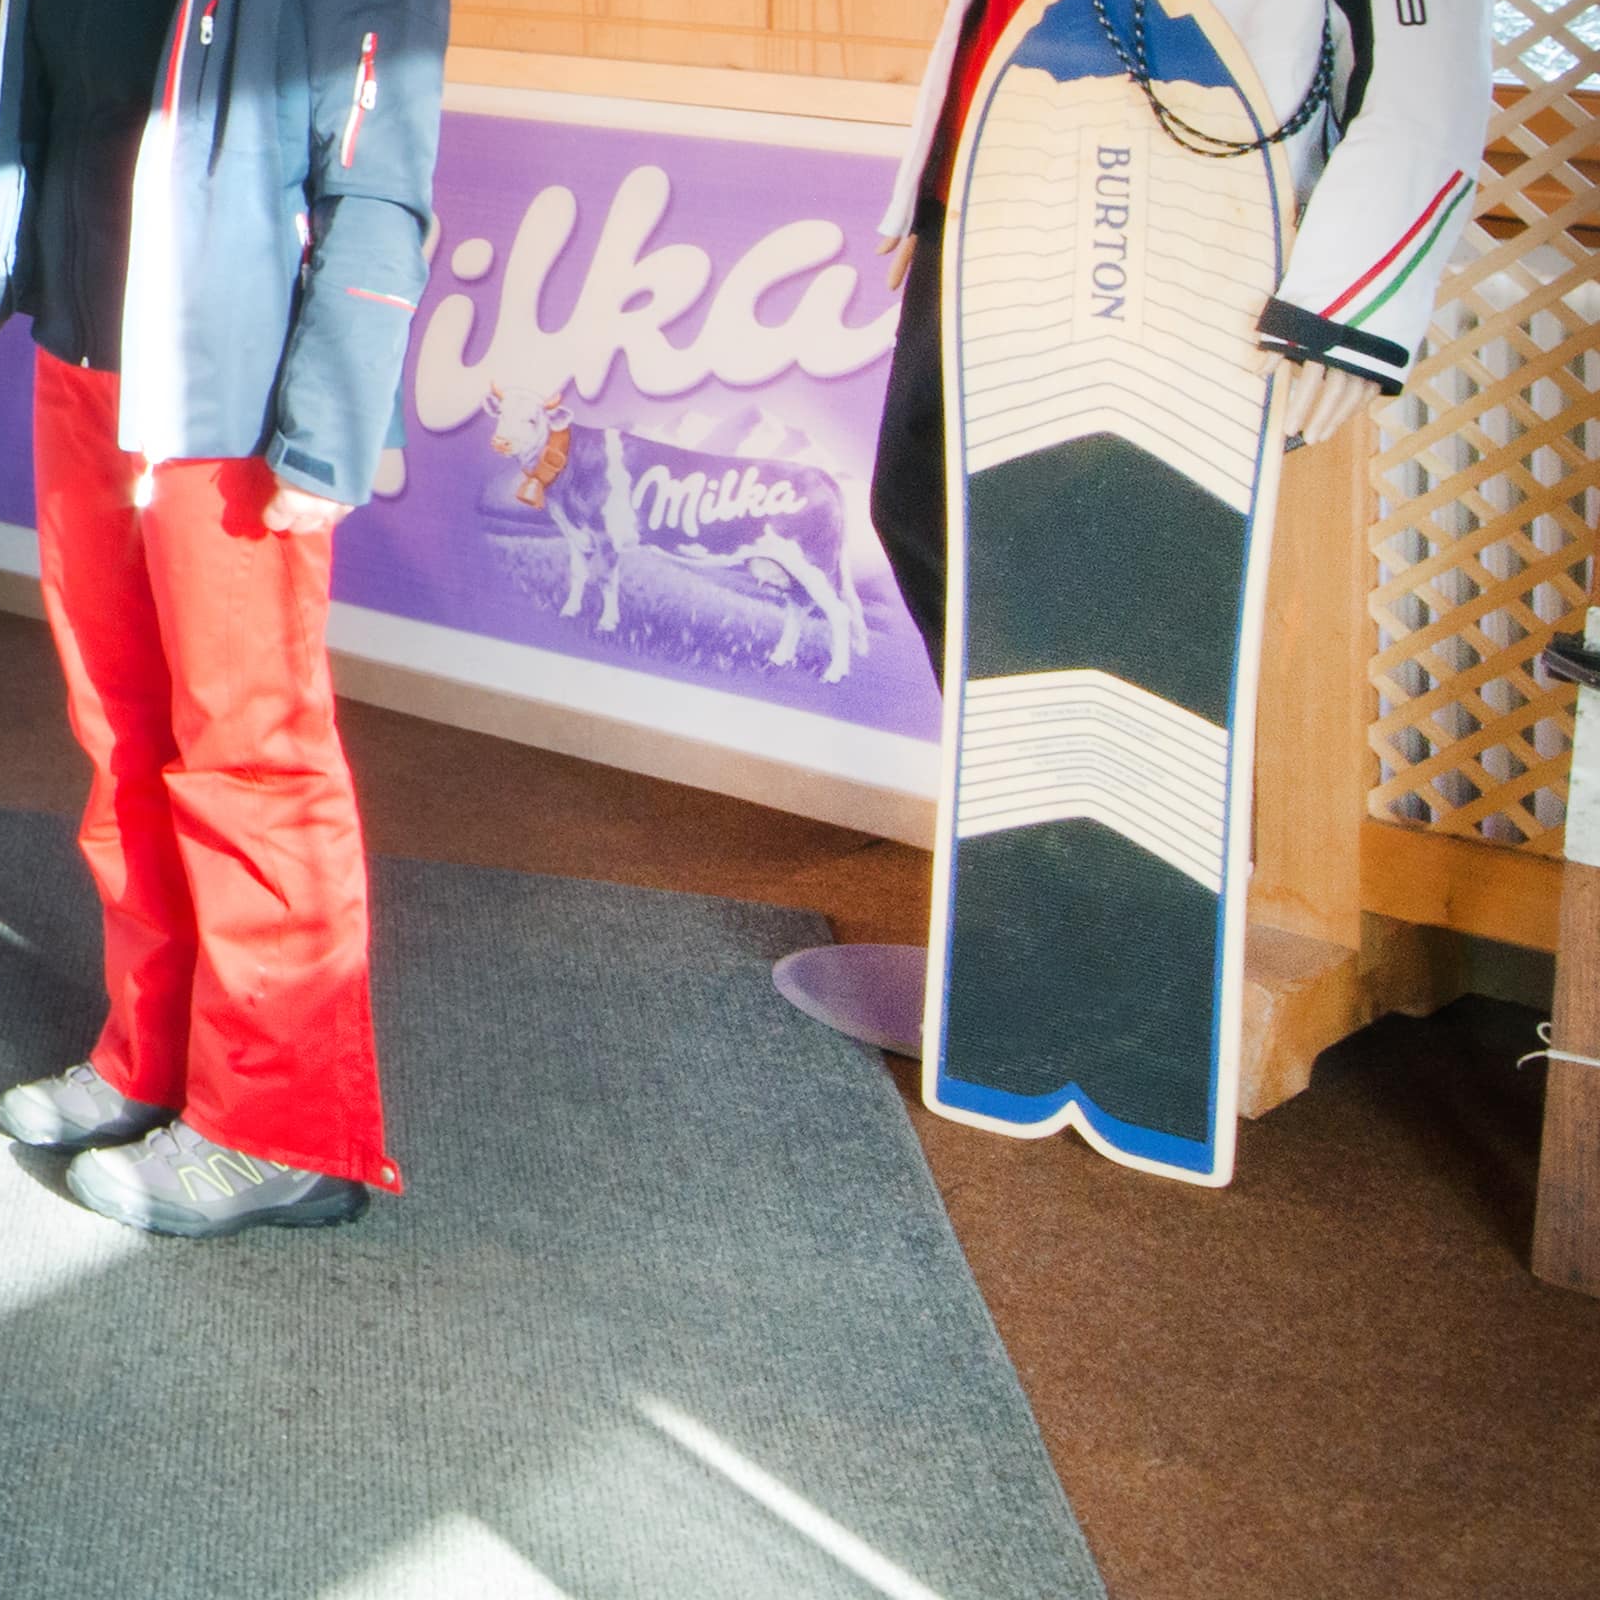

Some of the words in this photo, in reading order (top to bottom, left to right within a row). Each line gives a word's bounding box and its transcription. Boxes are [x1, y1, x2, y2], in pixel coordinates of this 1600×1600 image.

[412, 165, 902, 434] ilka
[1090, 146, 1132, 323] BURTON
[631, 463, 808, 538] Milka
